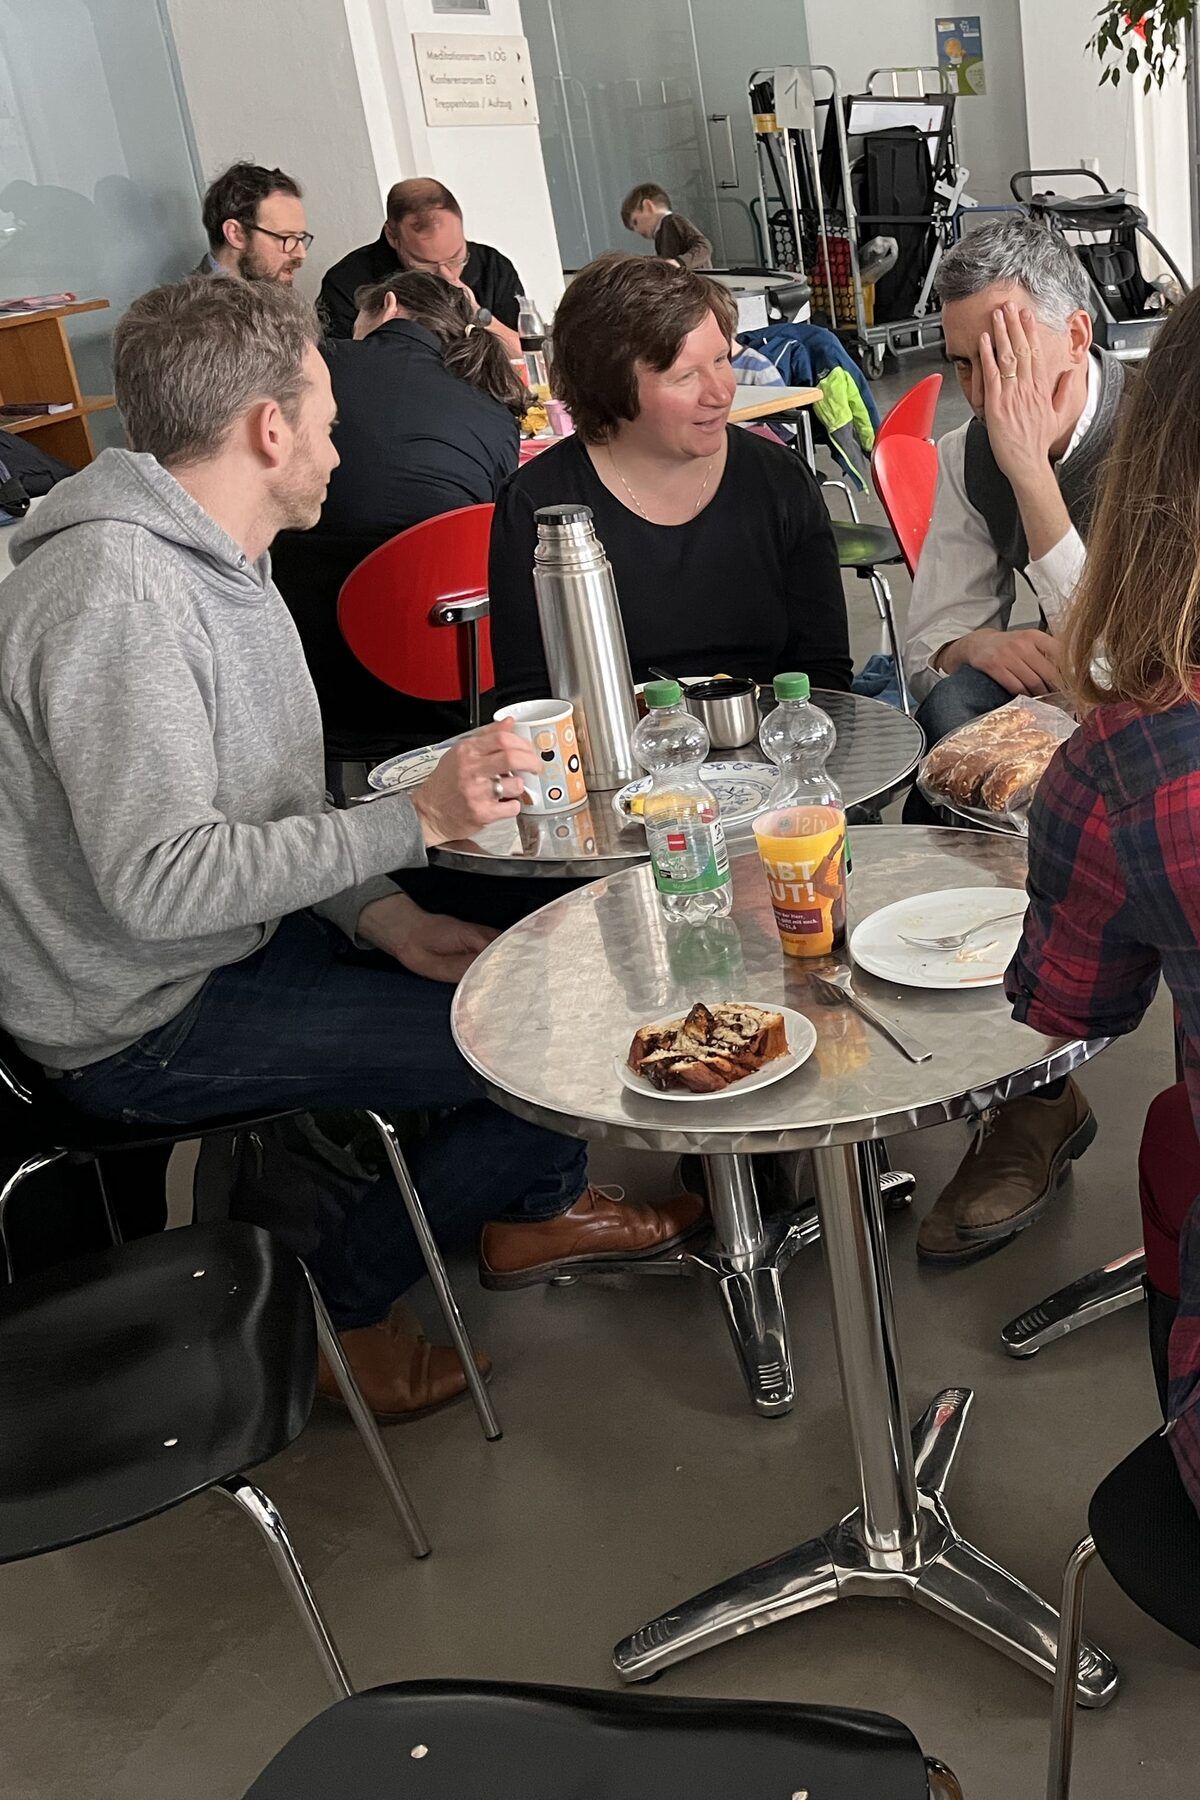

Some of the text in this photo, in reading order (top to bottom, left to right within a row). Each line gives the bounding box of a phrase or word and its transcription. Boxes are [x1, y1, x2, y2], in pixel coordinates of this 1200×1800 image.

[426, 50, 487, 61] Meditationsraum
[430, 74, 497, 85] Konferenzraum EG
[784, 78, 798, 109] 1
[434, 97, 480, 111] Treppenhaus
[488, 97, 512, 111] Aufzug
[762, 857, 816, 881] ABT
[769, 880, 817, 903] UT!
